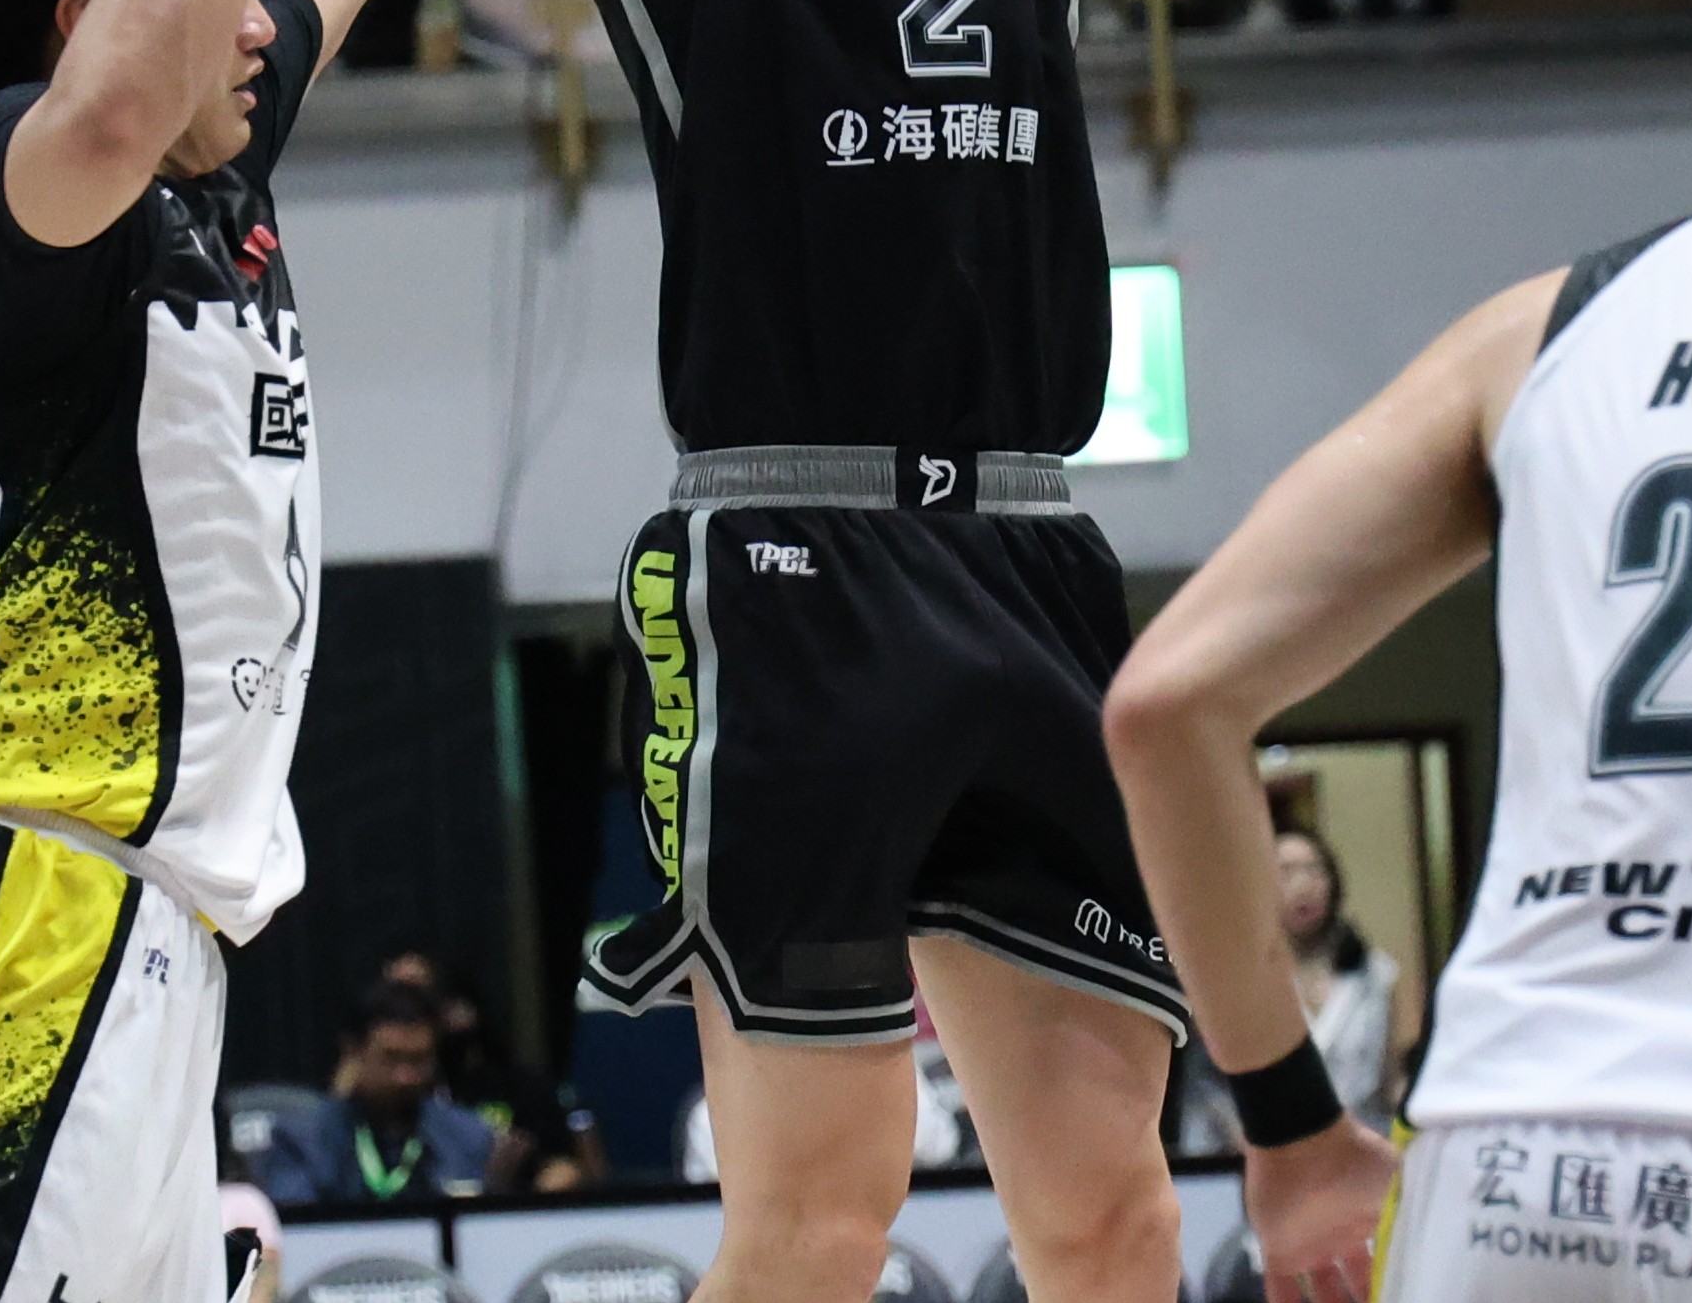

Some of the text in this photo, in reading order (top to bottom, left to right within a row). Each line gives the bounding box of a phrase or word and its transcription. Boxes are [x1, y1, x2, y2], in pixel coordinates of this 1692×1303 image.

[745, 541, 820, 578] TPBL
[1515, 862, 1678, 908] NEW
[1469, 1222, 1619, 1268] HONHU
